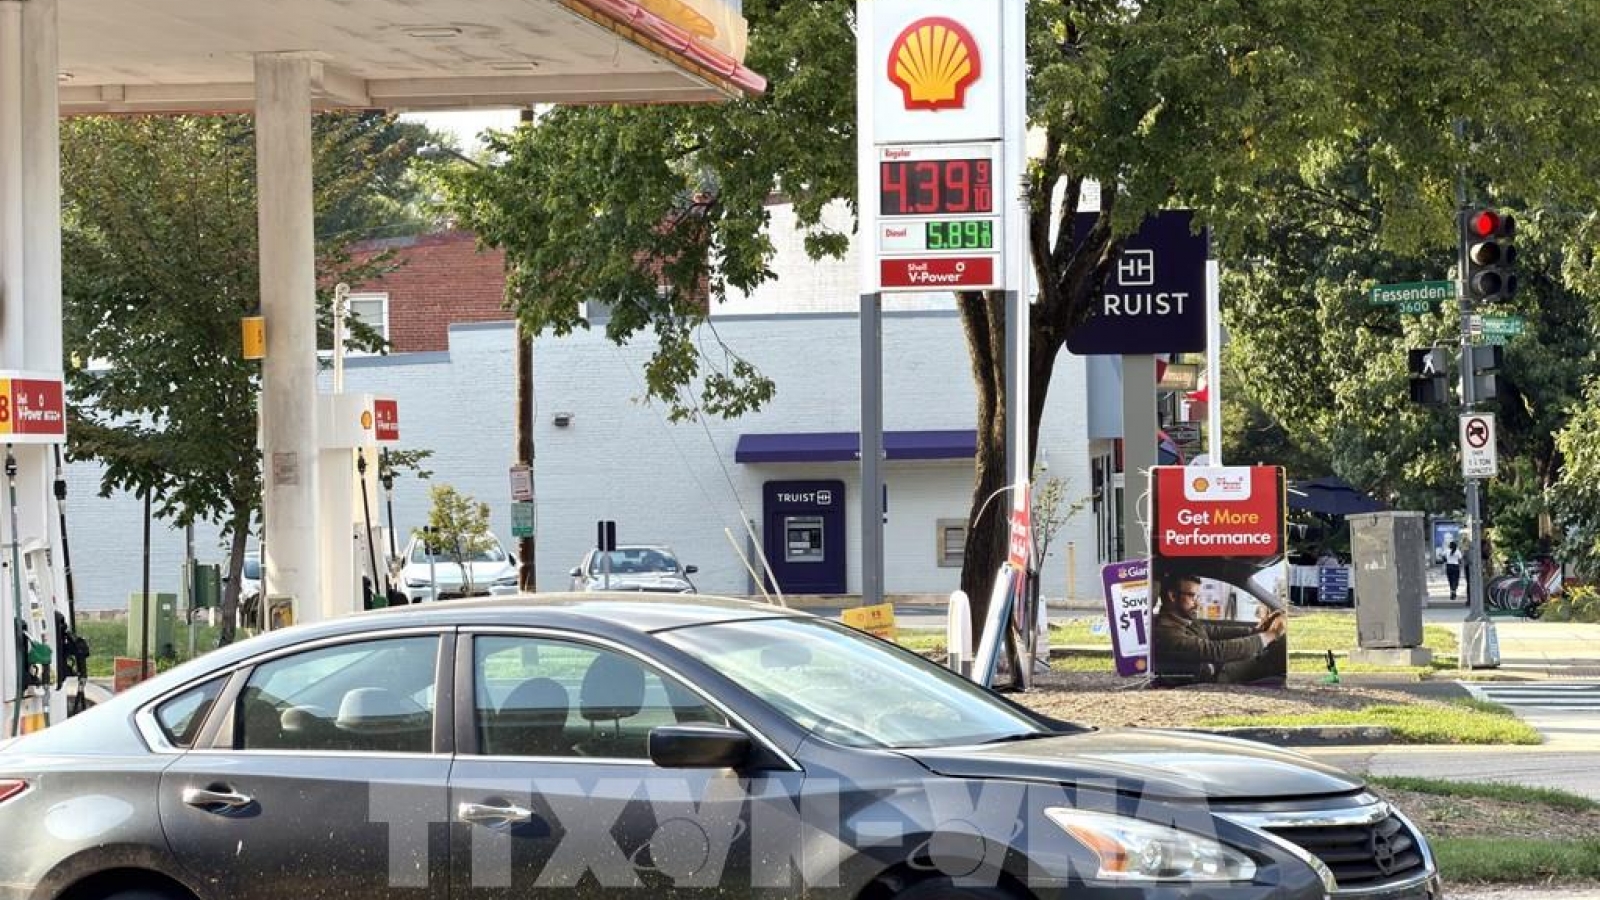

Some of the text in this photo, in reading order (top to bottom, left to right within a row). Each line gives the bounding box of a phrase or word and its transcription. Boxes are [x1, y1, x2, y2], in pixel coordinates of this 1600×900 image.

[885, 148, 910, 159] Regular
[882, 161, 970, 213] 4.39
[885, 228, 907, 237] Diesel
[929, 222, 978, 248] 5.89
[908, 263, 928, 271] Shell
[908, 272, 963, 282] V-Power
[1373, 286, 1446, 302] Fessenden
[1092, 293, 1188, 316] RUIST
[1399, 301, 1429, 313] 3600
[777, 493, 815, 502] TRUIST
[1177, 509, 1259, 525] Get More
[1166, 528, 1271, 545] Performance
[1128, 567, 1148, 577] Gian
[1120, 610, 1148, 646] $1
